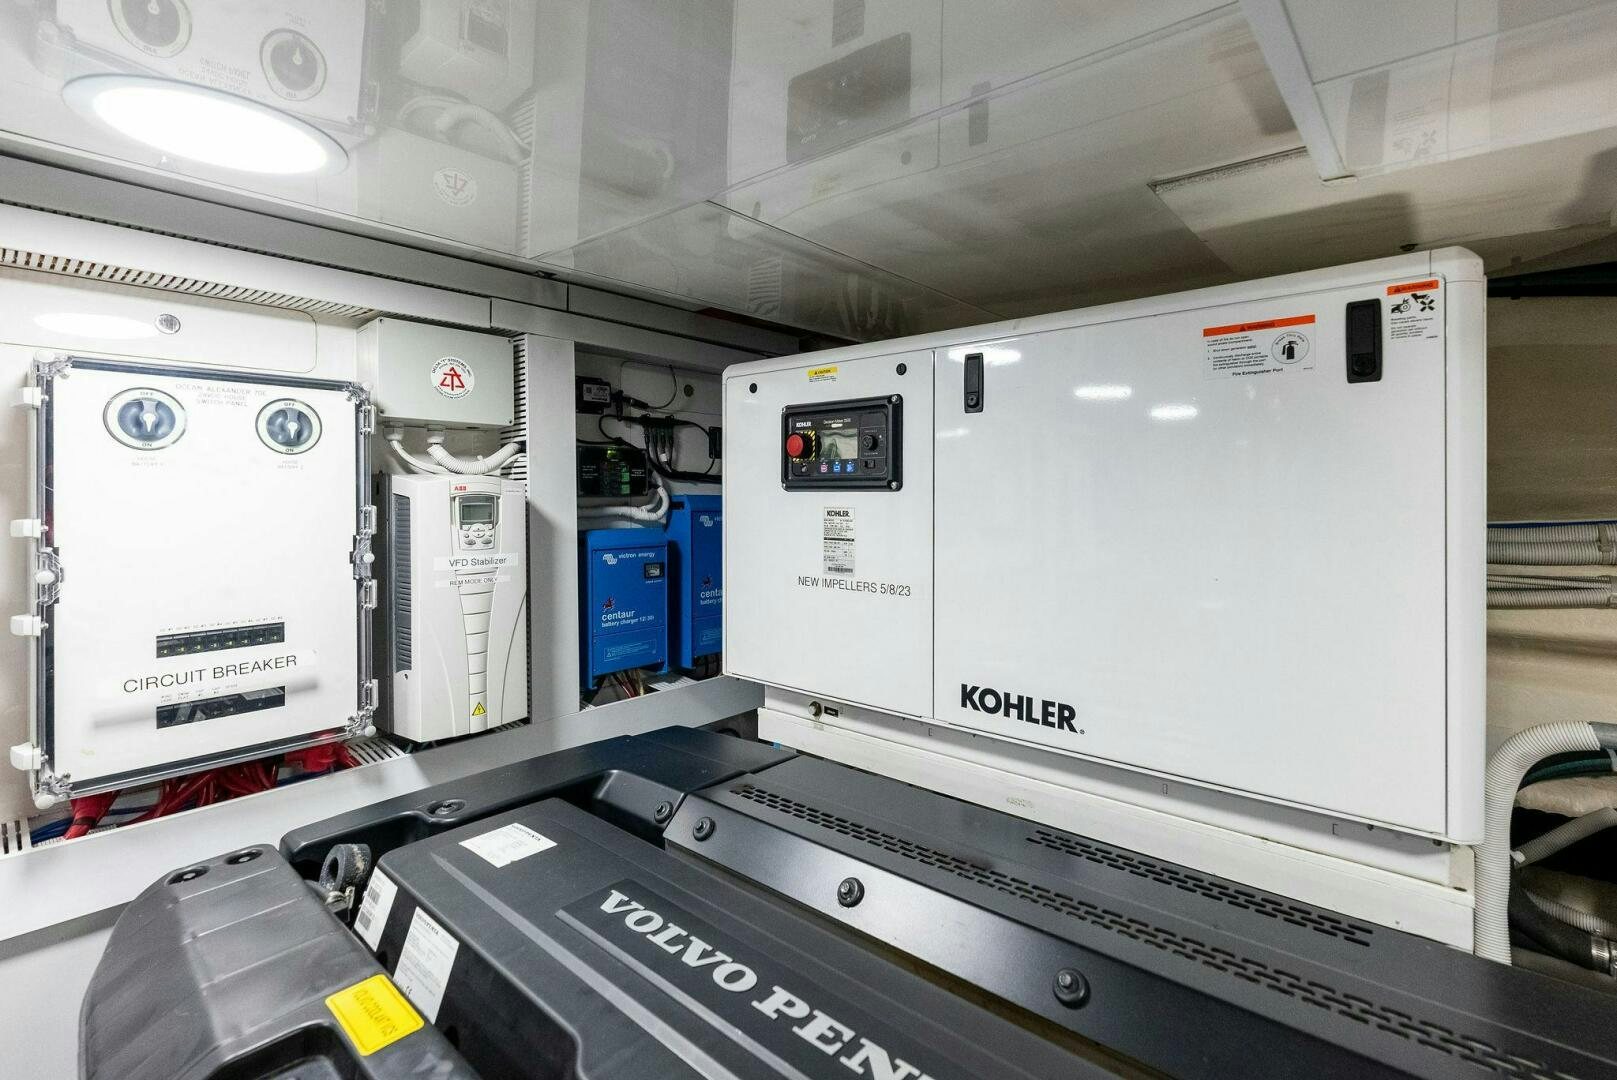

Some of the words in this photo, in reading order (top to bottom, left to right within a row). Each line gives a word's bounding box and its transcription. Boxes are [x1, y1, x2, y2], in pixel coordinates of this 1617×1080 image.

[449, 558, 469, 567] VFD
[470, 556, 507, 567] Stabilizer
[700, 588, 722, 599] centa
[798, 576, 820, 587] NEW
[822, 577, 878, 594] IMPELLERS
[880, 583, 911, 597] 5/8/23
[601, 610, 636, 622] centaur
[123, 668, 207, 693] CIRCUIT
[213, 654, 297, 680] BREAKER
[960, 683, 1079, 734] KOHLER
[600, 889, 758, 993] VOLVO
[751, 985, 939, 1080] PEN
